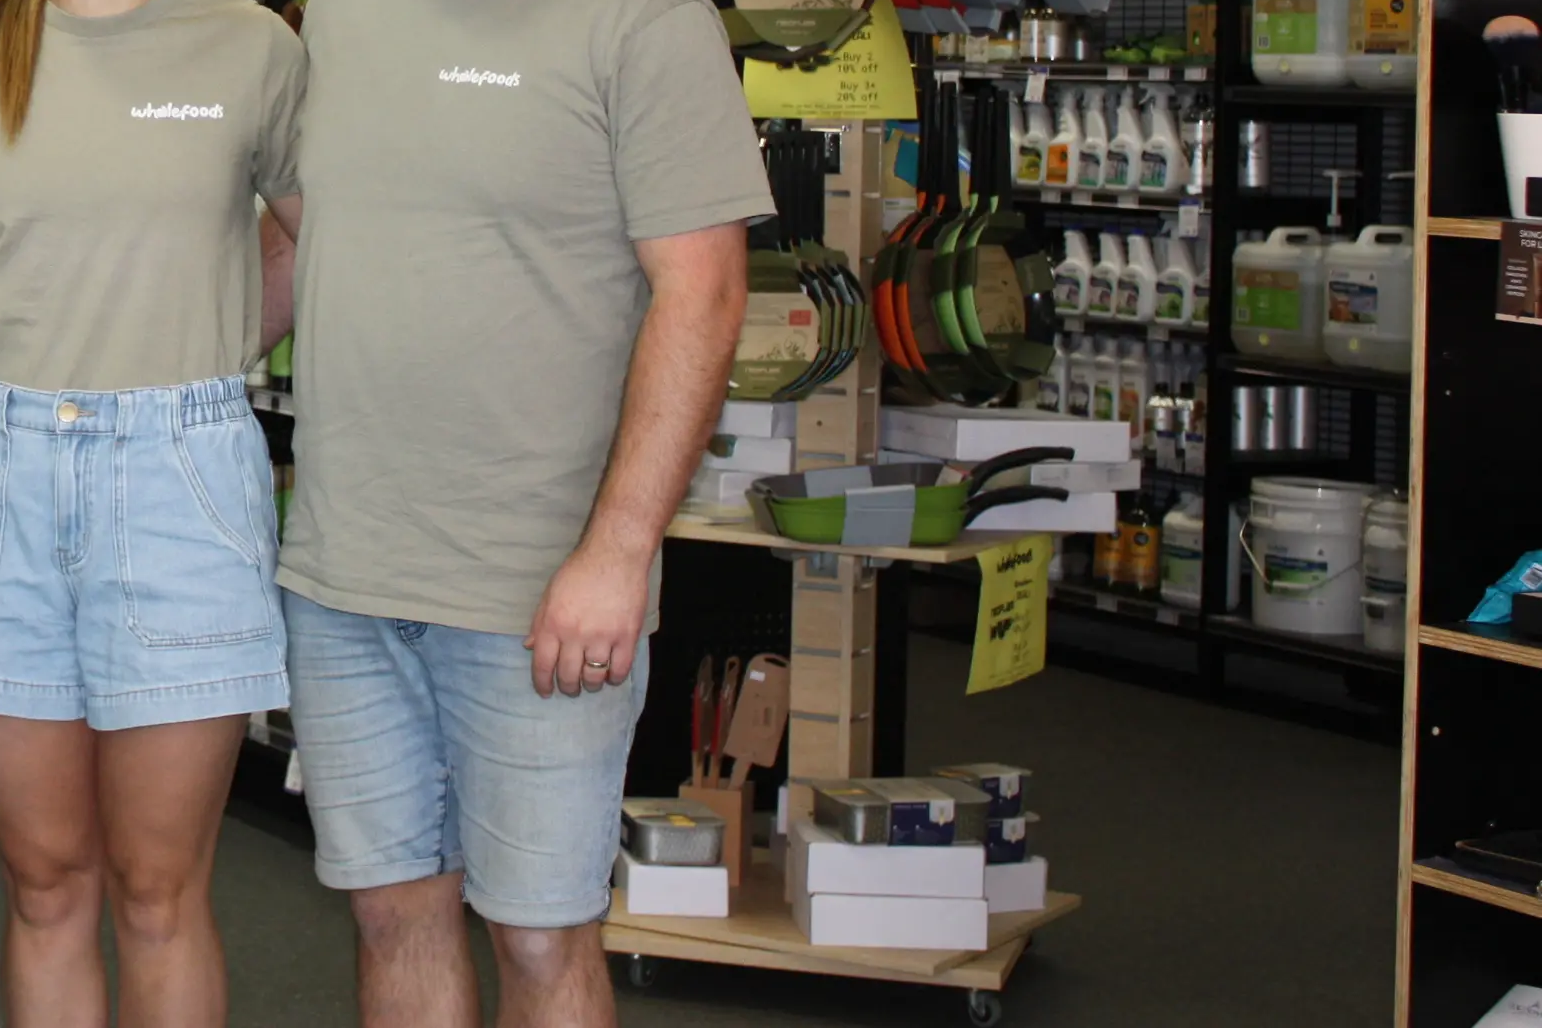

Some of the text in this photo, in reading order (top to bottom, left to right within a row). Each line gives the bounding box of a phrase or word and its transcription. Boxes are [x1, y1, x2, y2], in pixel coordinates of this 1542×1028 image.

[843, 52, 874, 62] Buy 2
[838, 64, 879, 73] 10% off
[439, 66, 521, 87] wholefoods
[840, 81, 859, 91] Buy
[837, 93, 879, 102] 20% off
[131, 102, 224, 120] wholefoods
[1521, 239, 1536, 248] FOR
